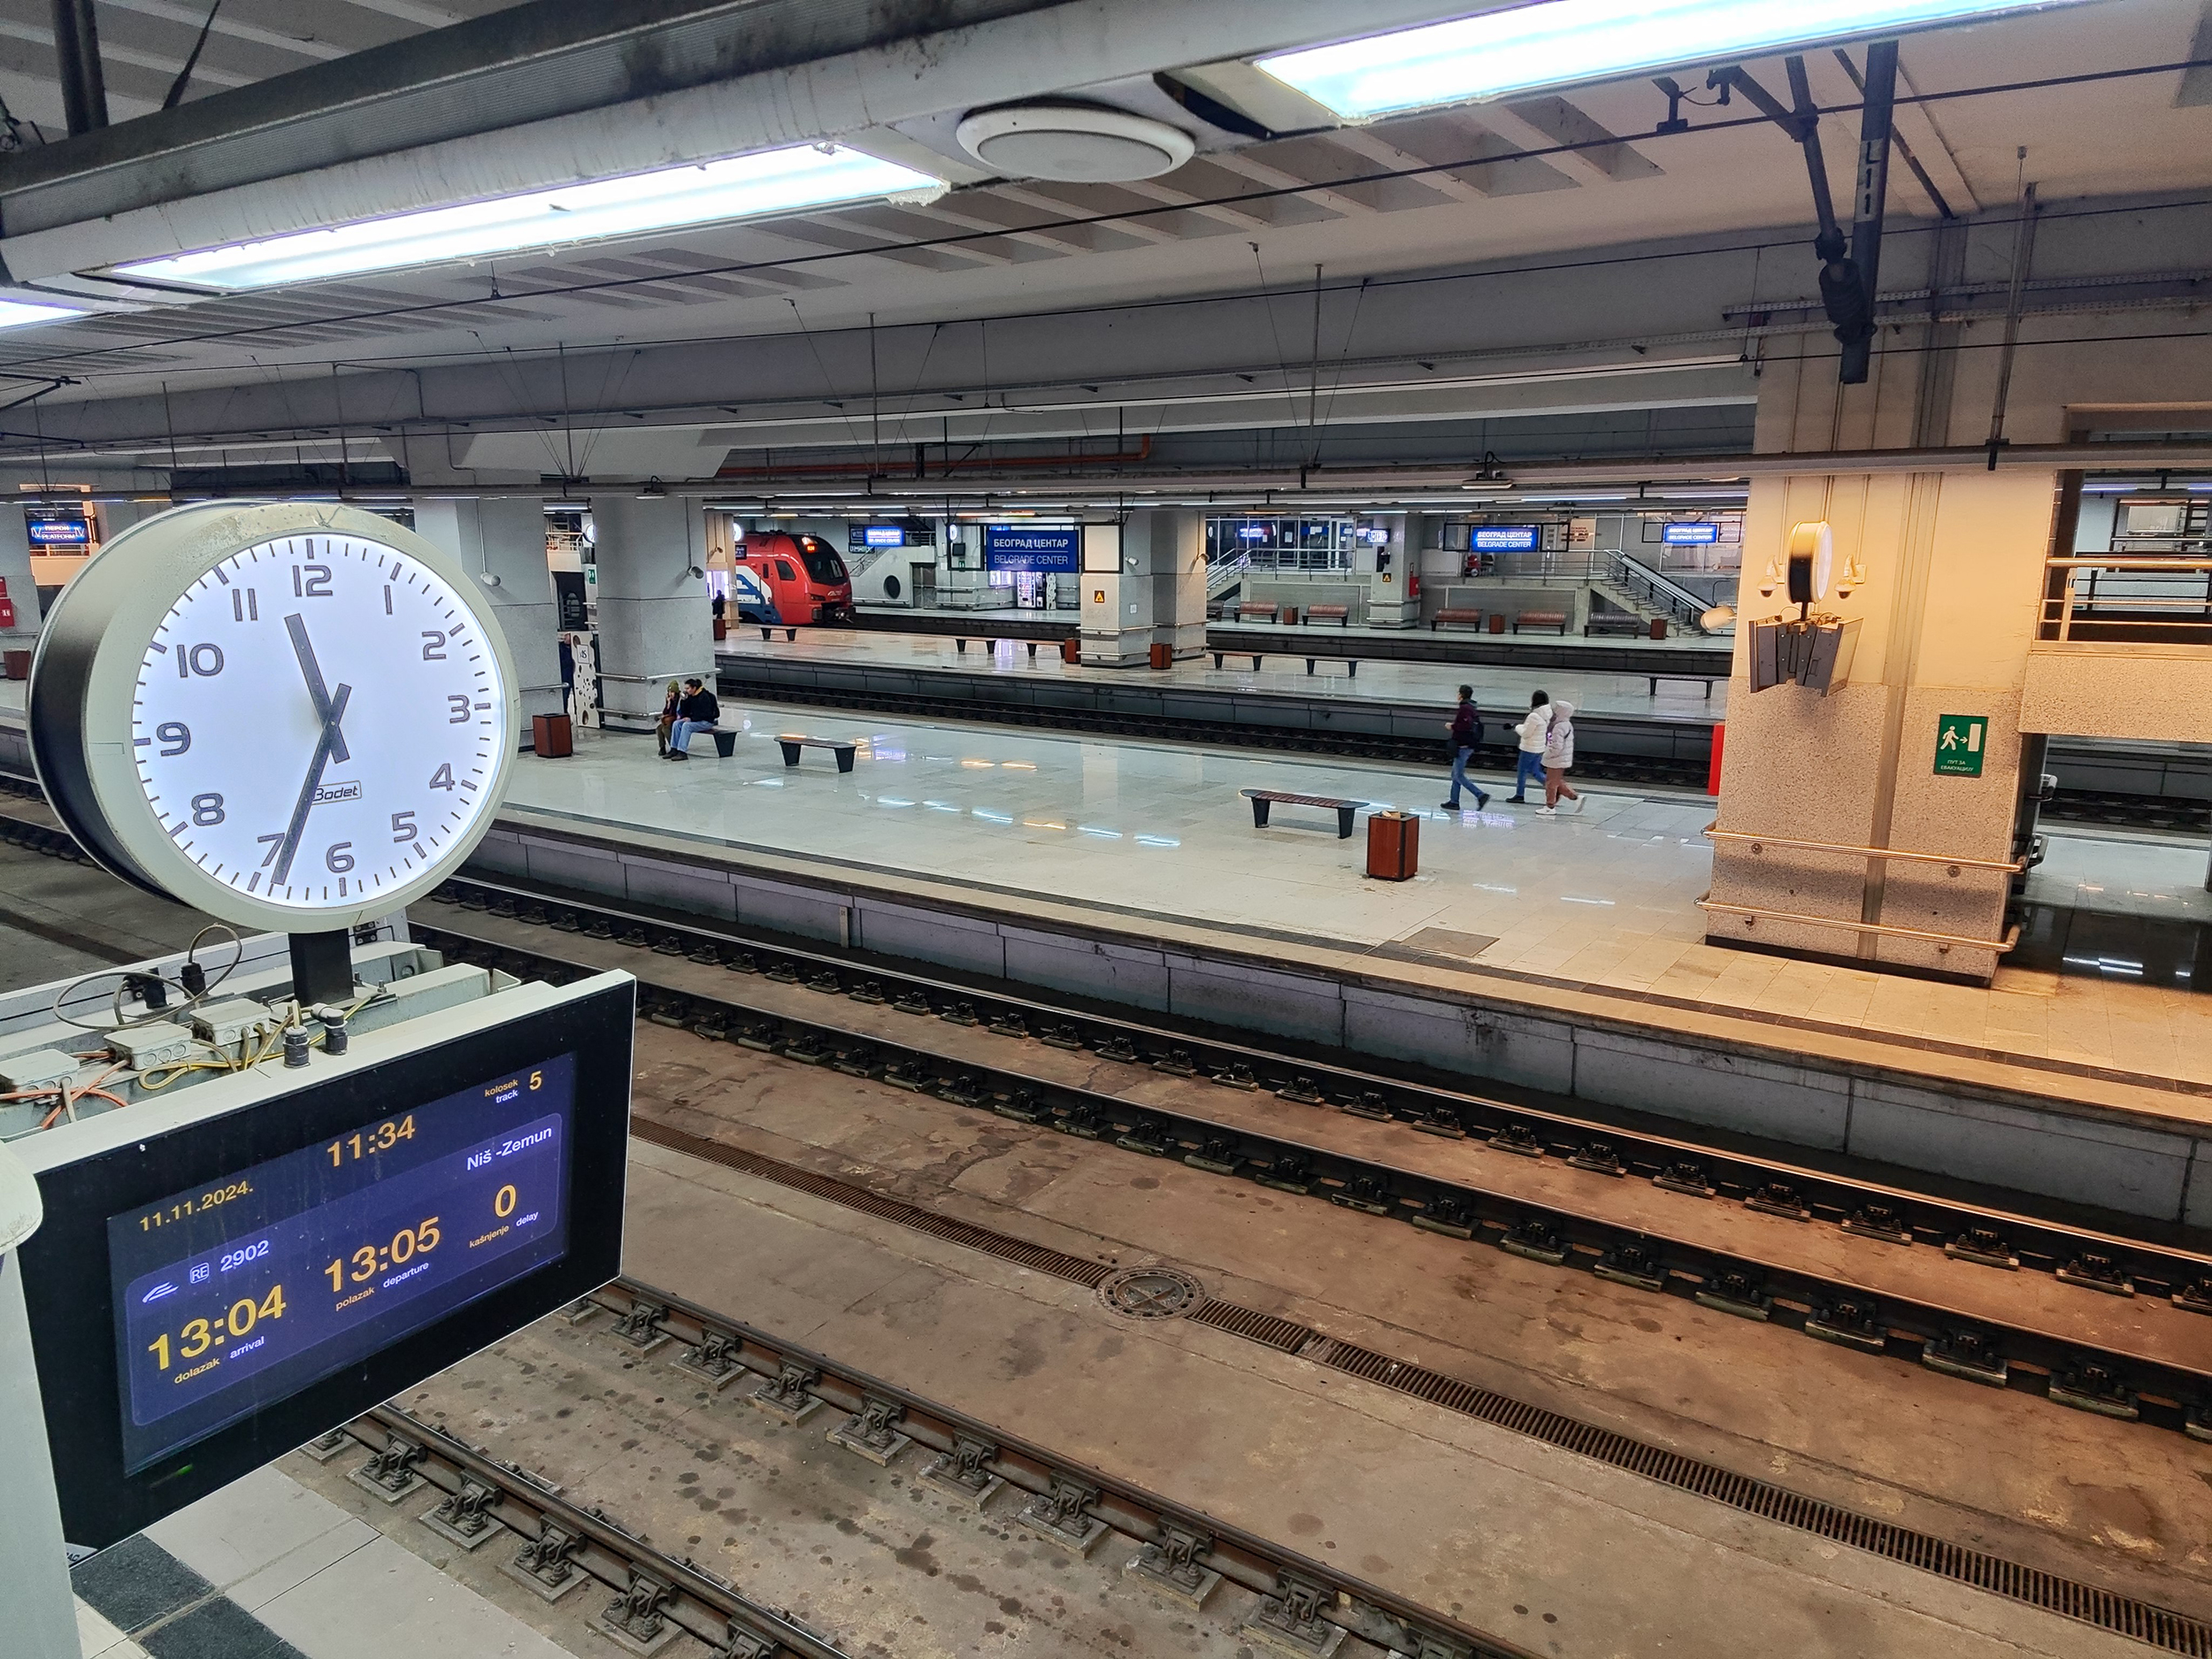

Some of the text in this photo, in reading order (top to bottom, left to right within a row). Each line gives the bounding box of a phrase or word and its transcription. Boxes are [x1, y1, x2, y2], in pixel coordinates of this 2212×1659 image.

[994, 539, 1068, 549] БЕОГРАД ЦЕНТАР
[995, 555, 1068, 565] BELGRADE CENTER
[292, 565, 333, 597] 12
[232, 588, 258, 621] 11
[384, 585, 393, 615] 1
[177, 642, 225, 678] 10
[421, 630, 447, 661] 2
[448, 695, 471, 724] 3
[156, 722, 191, 757] 9
[429, 763, 456, 791] 4
[191, 793, 225, 826] 8
[392, 811, 418, 843] 5
[257, 833, 285, 867] 7
[326, 841, 355, 873] 6
[485, 1071, 541, 1096] kolosek 5
[495, 1090, 518, 1103] track
[327, 1115, 415, 1167] 11:34
[467, 1127, 551, 1171] Niš -Zemun
[140, 1180, 253, 1231] 11.11.2024.
[495, 1185, 516, 1217] 0
[469, 1211, 539, 1248] kašnjenje delay
[192, 1240, 269, 1282] RE 2902
[325, 1217, 441, 1293] 13:05
[336, 1263, 429, 1311] polazak departure
[149, 1285, 287, 1370] 13:04
[174, 1336, 265, 1384] dolazak arrival
